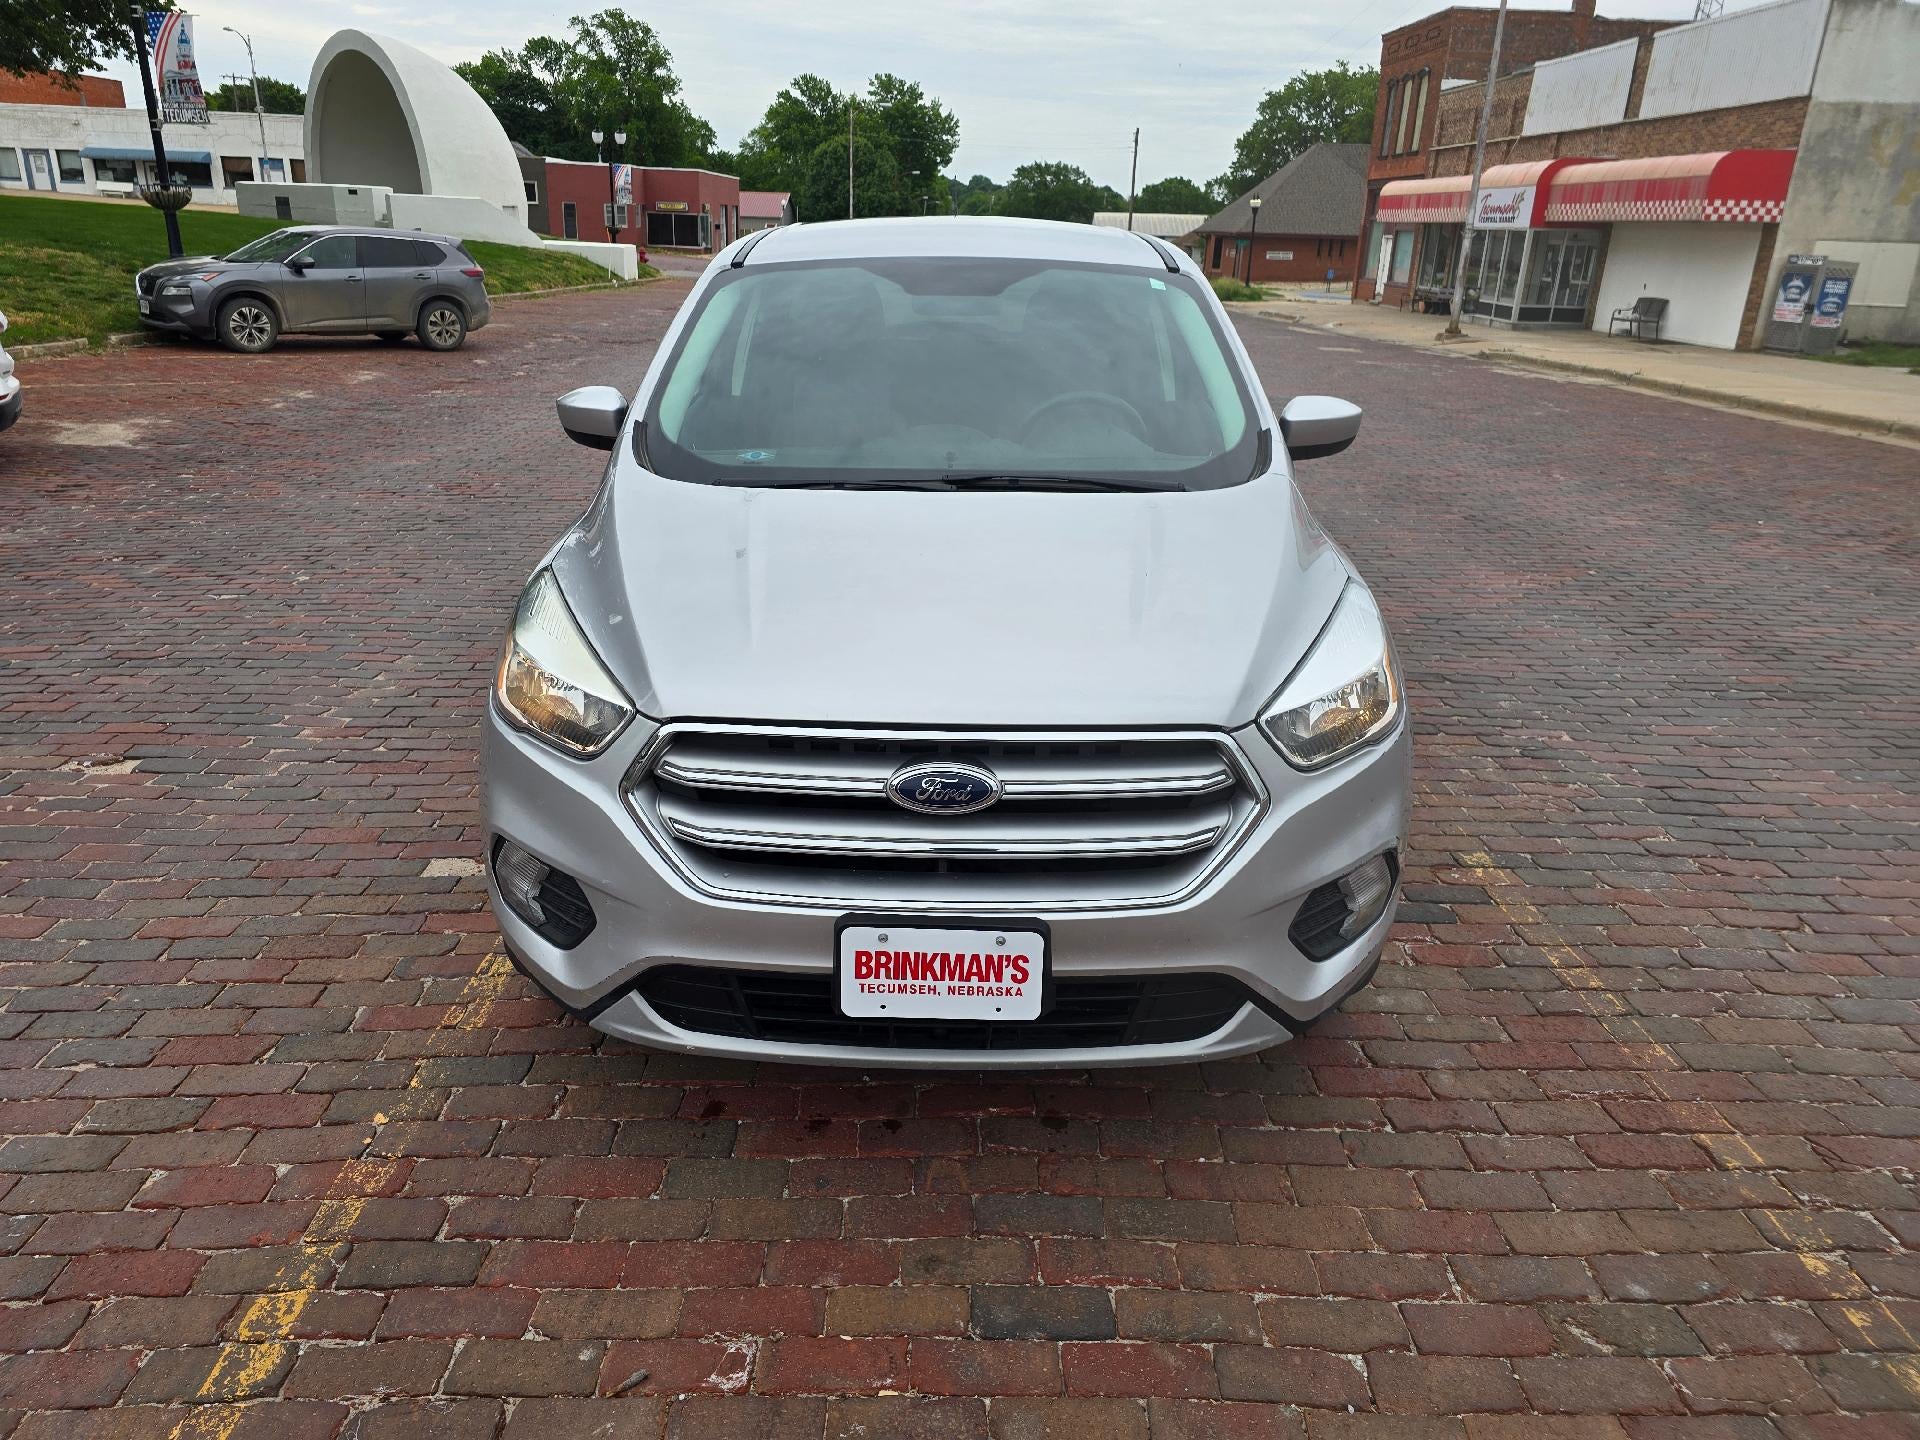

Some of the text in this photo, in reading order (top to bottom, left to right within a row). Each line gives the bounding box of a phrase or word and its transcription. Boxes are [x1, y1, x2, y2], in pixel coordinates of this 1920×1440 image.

[164, 108, 209, 123] TECUMSEH
[916, 777, 973, 801] Ford
[855, 950, 1030, 985] BRINKMAN'S
[859, 983, 1023, 997] TECUMSEH, NEBRASKA
